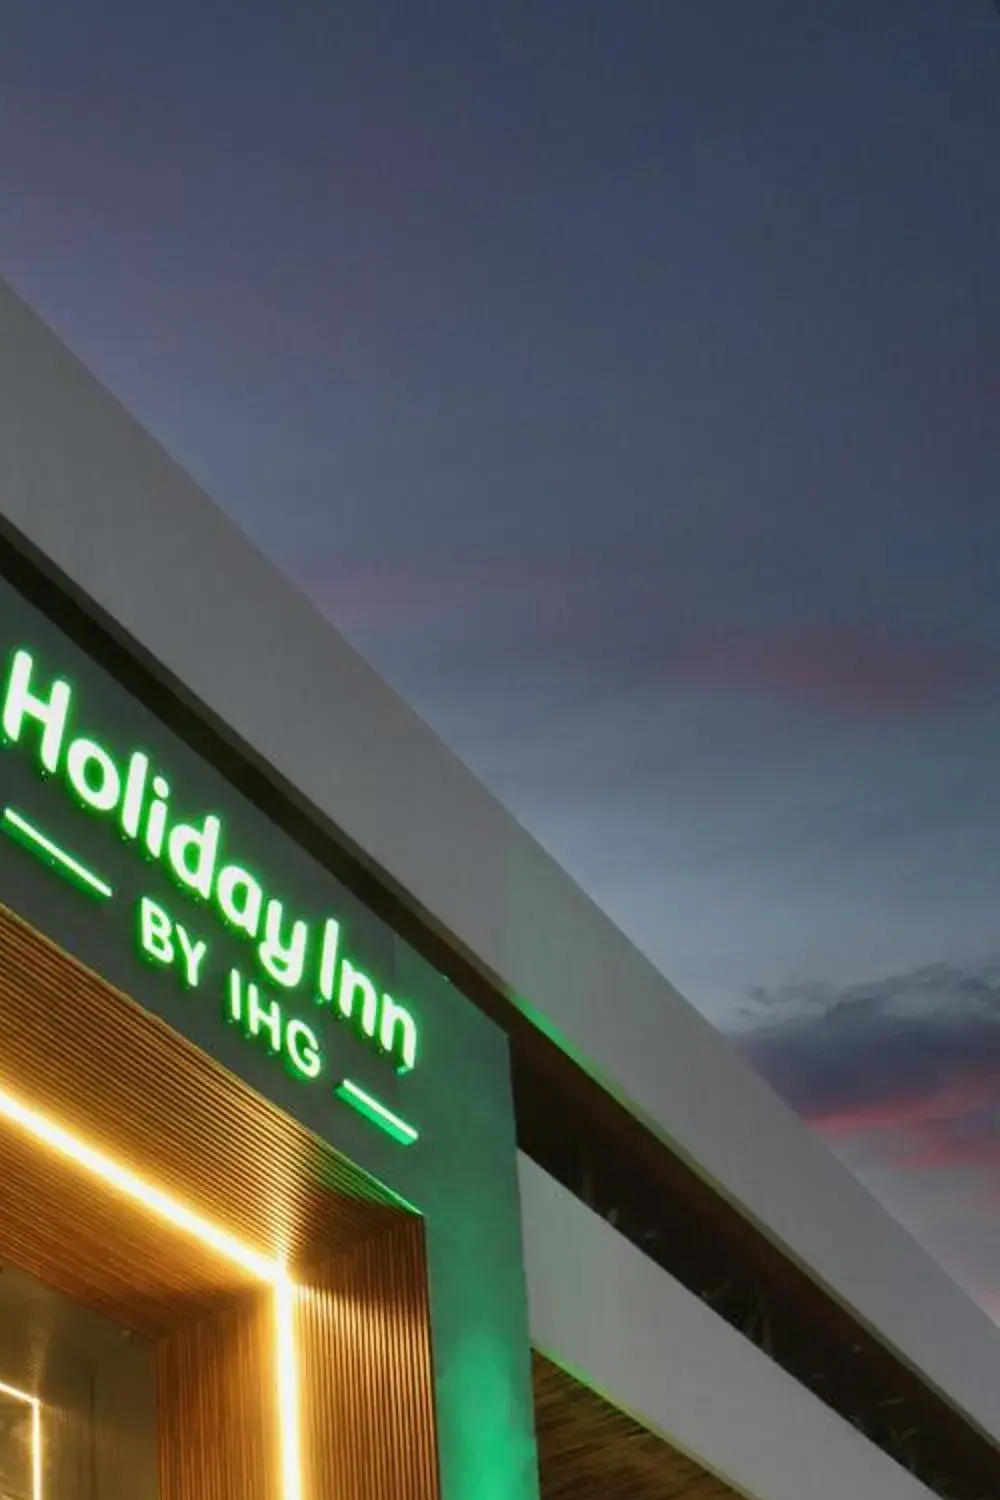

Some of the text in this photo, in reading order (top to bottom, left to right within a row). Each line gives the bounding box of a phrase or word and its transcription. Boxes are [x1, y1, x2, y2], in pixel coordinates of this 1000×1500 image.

[3, 651, 417, 1072] Holiday Inn
[141, 896, 321, 1078] BY IHG
